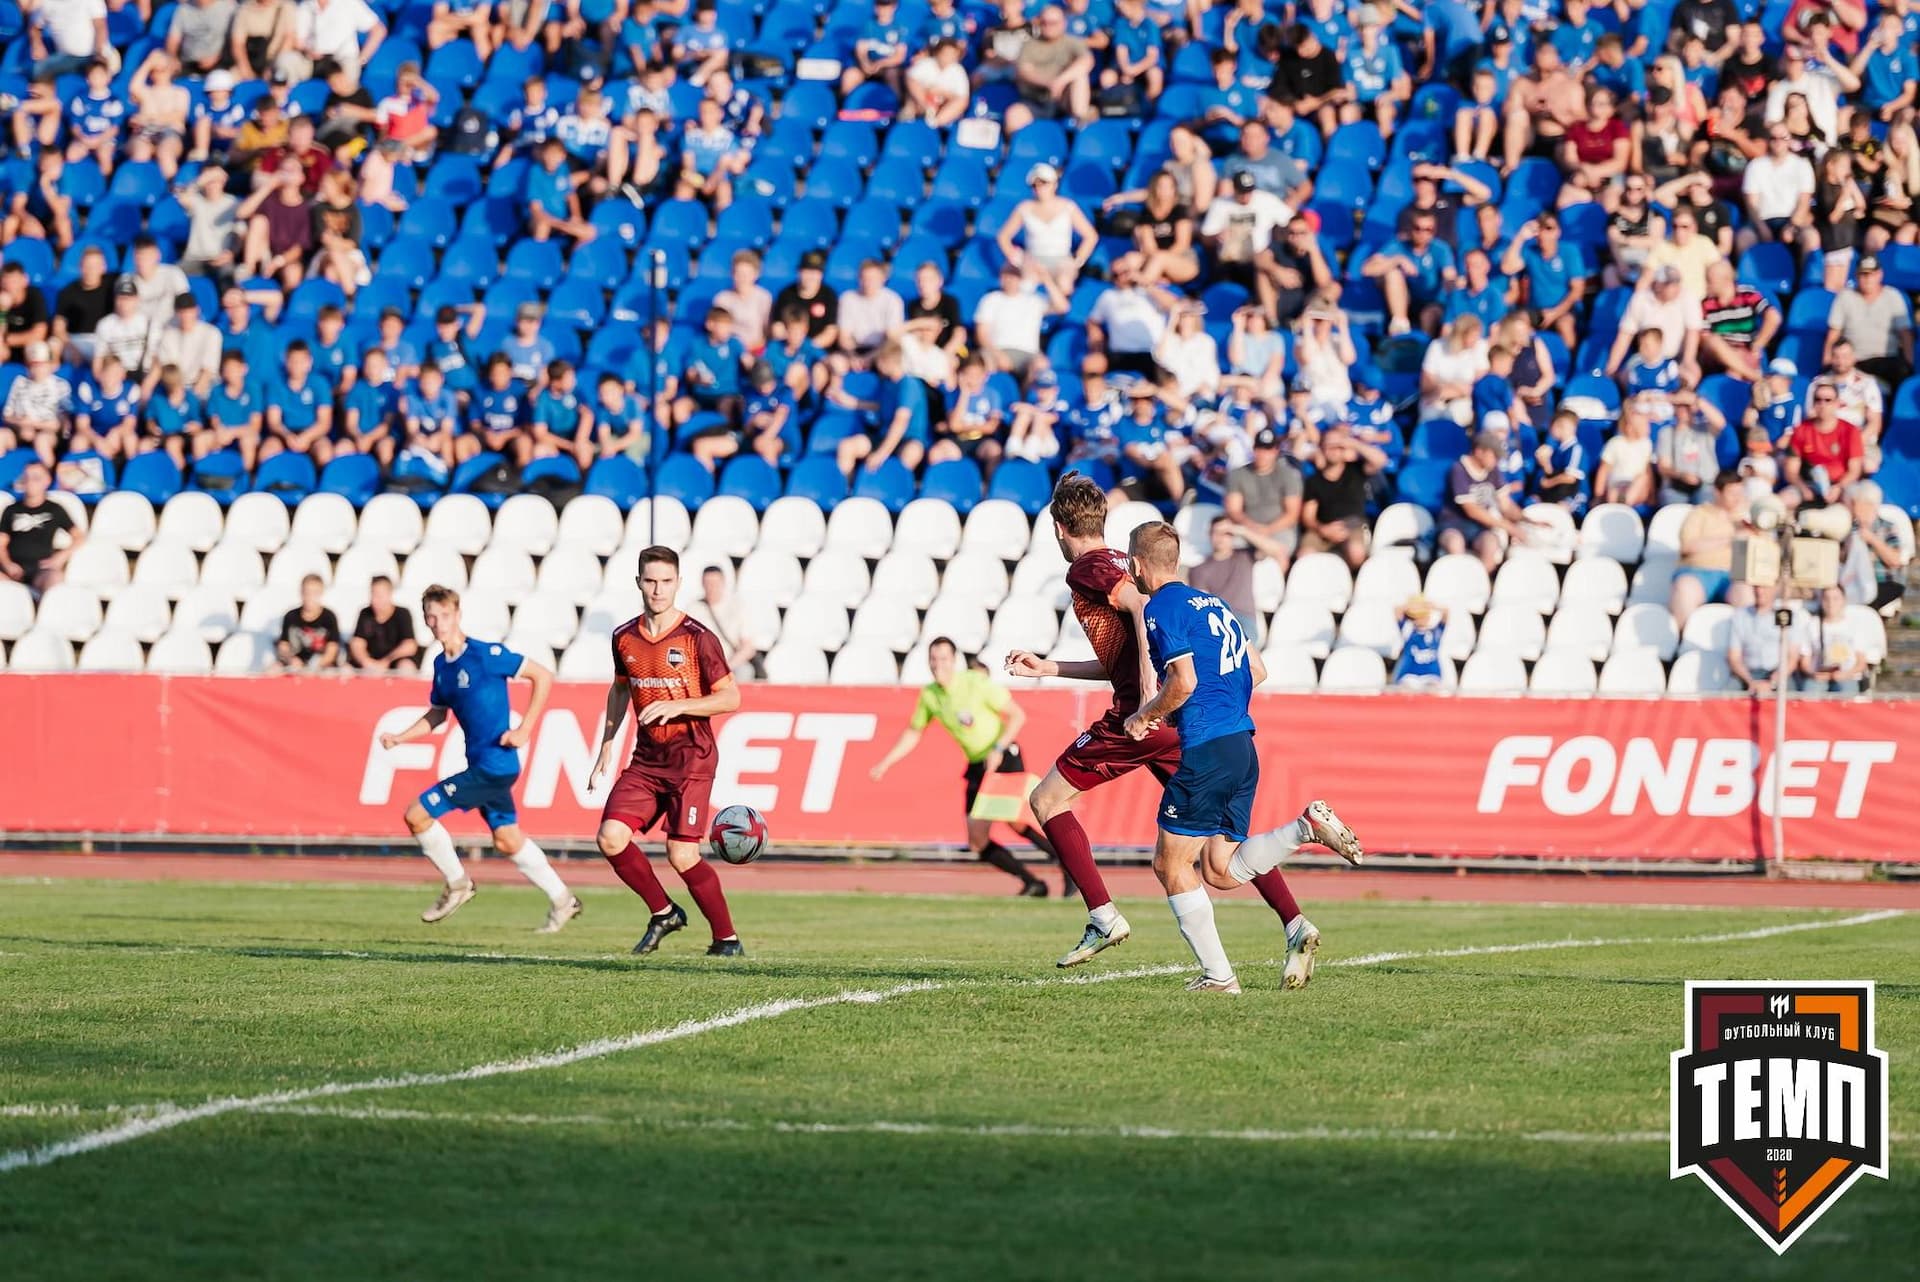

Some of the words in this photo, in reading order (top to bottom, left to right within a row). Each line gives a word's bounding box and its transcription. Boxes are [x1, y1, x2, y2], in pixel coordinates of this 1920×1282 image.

[1208, 606, 1247, 676] 20
[359, 706, 877, 812] FNET
[1477, 735, 1898, 818] FONBET
